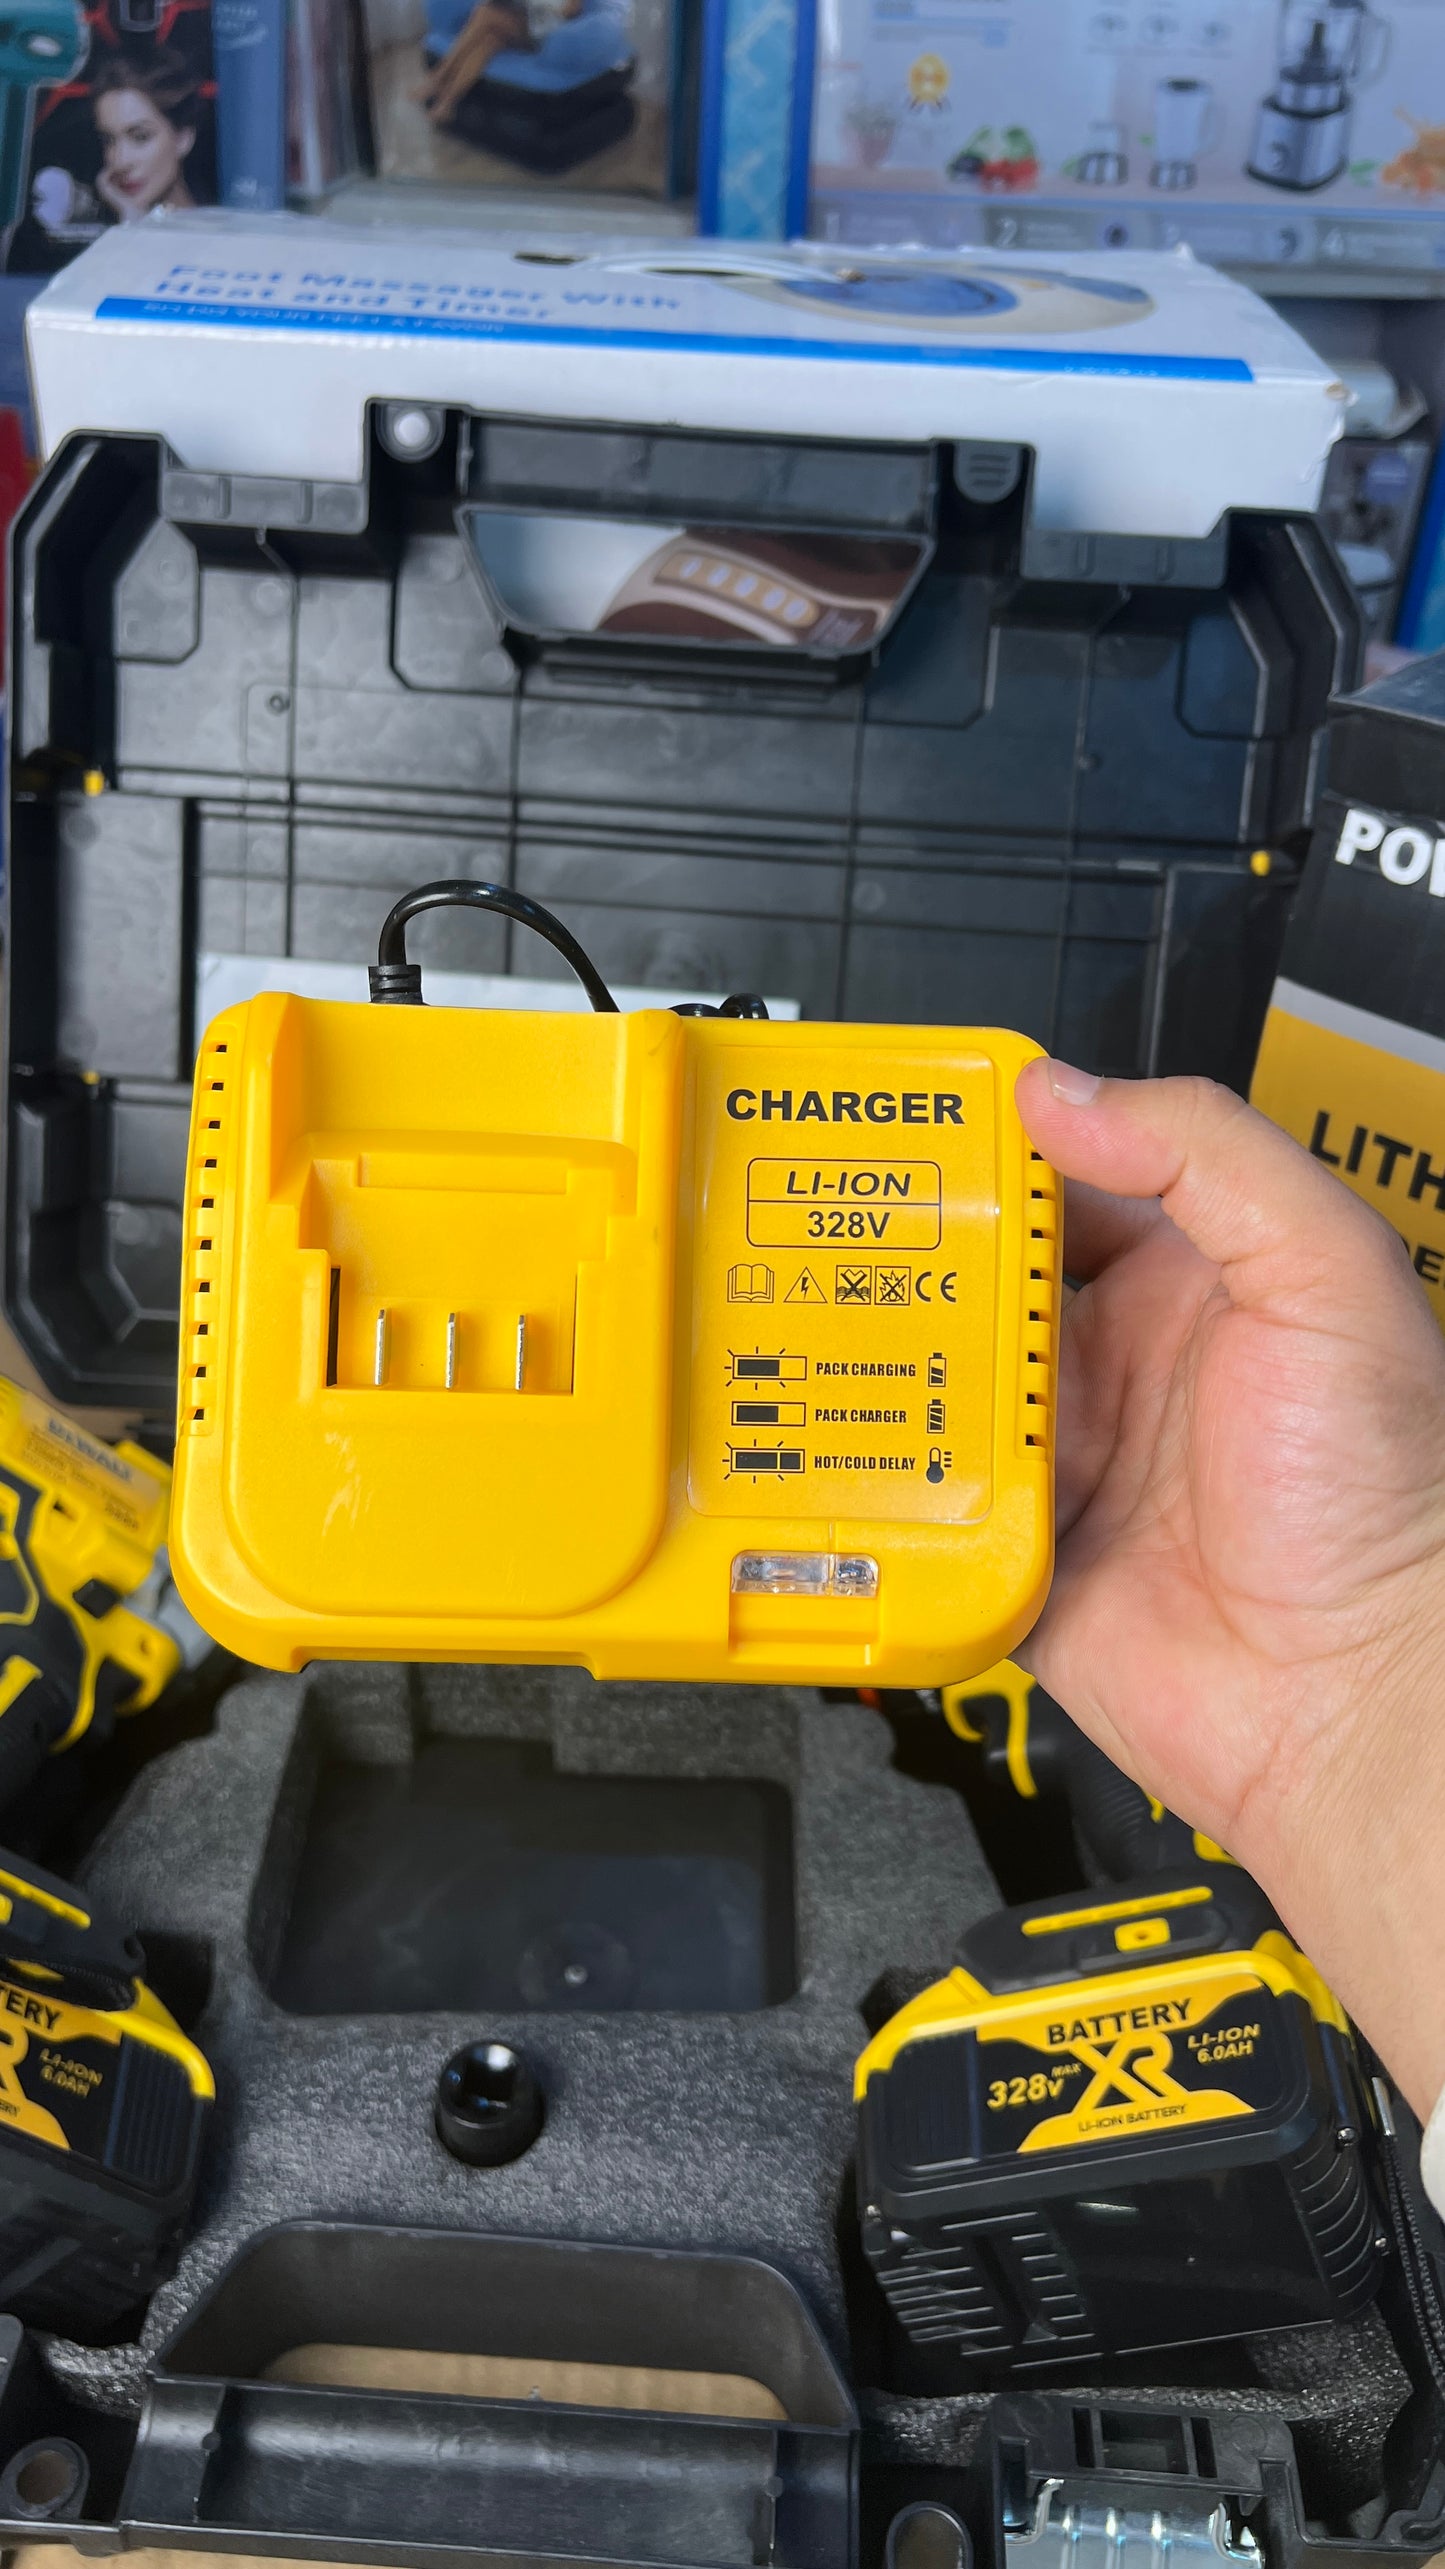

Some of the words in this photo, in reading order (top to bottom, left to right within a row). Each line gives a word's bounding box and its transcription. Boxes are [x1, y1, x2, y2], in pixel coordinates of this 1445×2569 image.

[170, 264, 282, 283] Foot
[302, 272, 545, 301] Massager
[155, 281, 274, 298] Heat
[293, 293, 390, 307] and
[408, 296, 553, 319] Timer
[1335, 808, 1445, 897] PO
[726, 1089, 965, 1124] CHARGER
[787, 1171, 911, 1196] LI-ION
[807, 1211, 890, 1238] 328V
[816, 1362, 849, 1376] PACK
[852, 1363, 916, 1377] CHARGING
[815, 1409, 847, 1422] PACK
[850, 1409, 906, 1423] CHARGER
[814, 1456, 876, 1470] HOT/COLD
[879, 1457, 916, 1470] DELAY
[0, 1983, 62, 2030] ERY
[1047, 1998, 1191, 2046] BATTERY
[1187, 2024, 1261, 2049] LI-ION
[1197, 2041, 1254, 2064] 6.0AH
[1126, 2103, 1187, 2125] BATTERY
